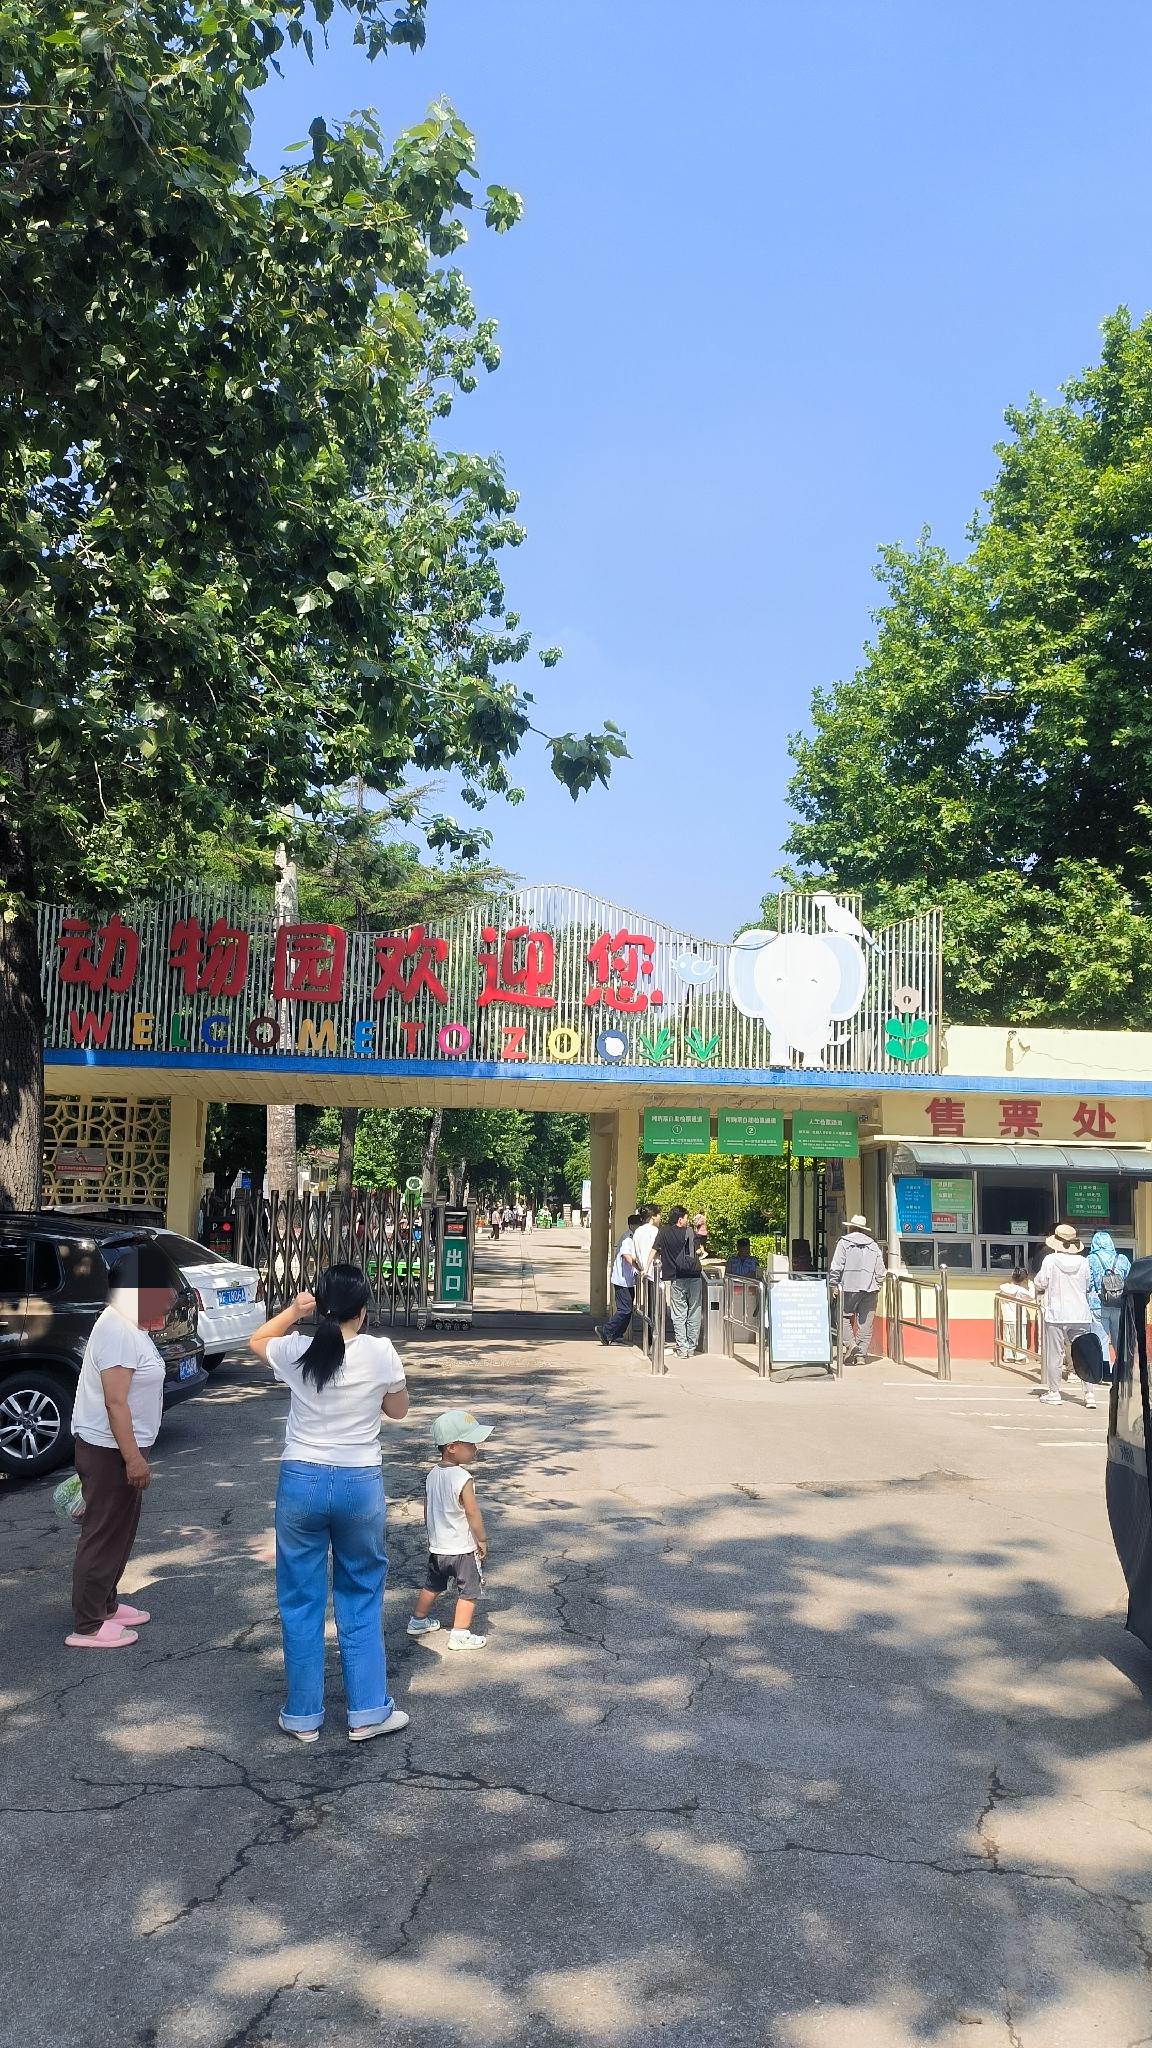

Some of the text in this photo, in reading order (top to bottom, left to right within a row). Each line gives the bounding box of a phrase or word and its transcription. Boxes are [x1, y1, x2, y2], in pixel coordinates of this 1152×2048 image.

[57, 915, 662, 1013] 动物园欢迎您
[71, 1010, 629, 1060] WELCOME TO ZOO
[925, 1097, 1116, 1139] 售票处
[445, 1248, 463, 1292] 出口
